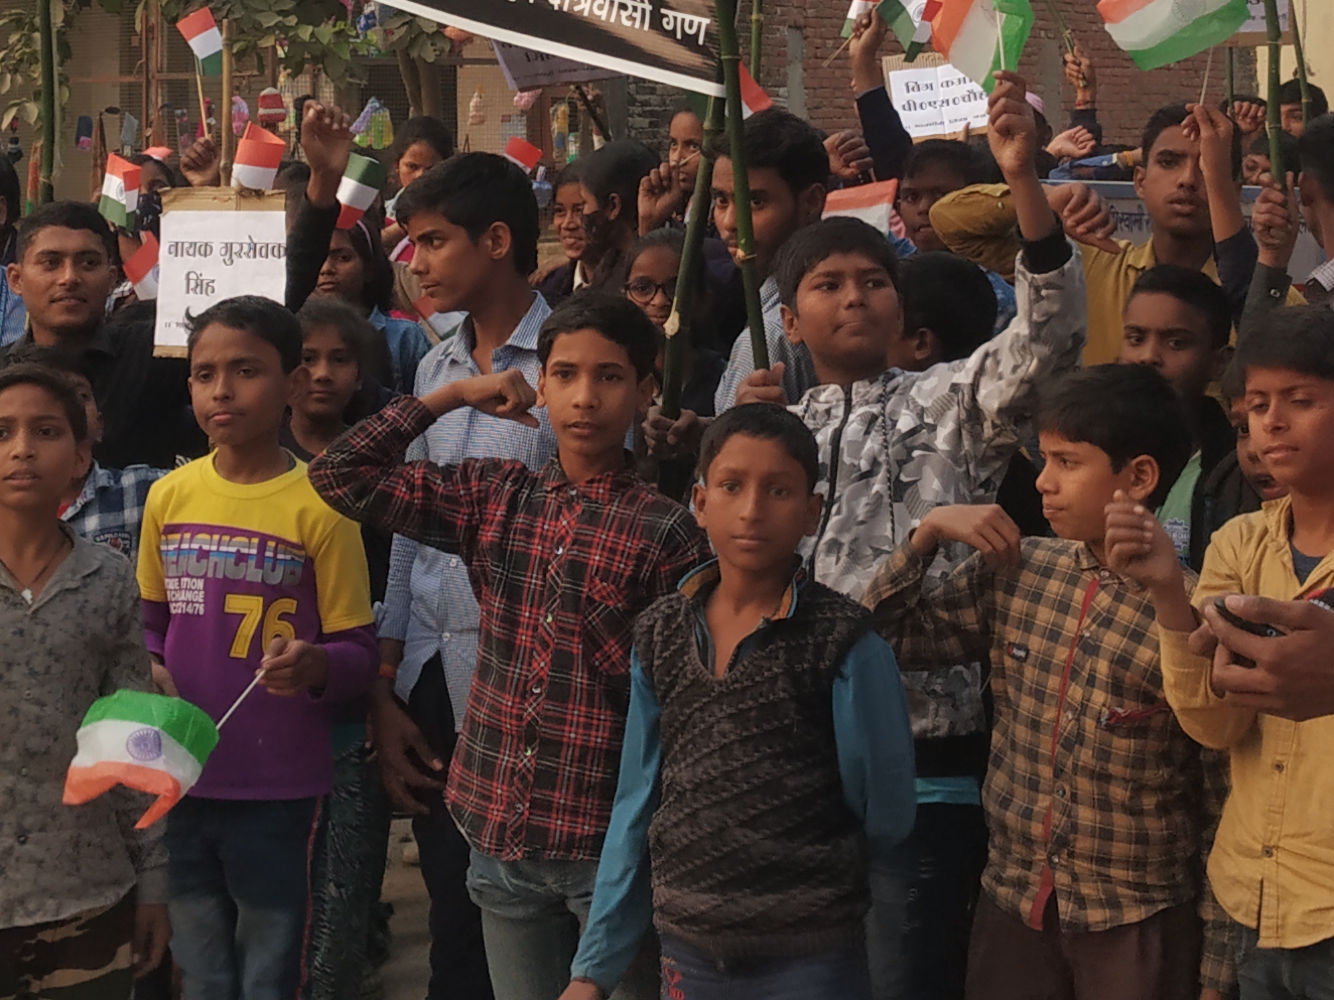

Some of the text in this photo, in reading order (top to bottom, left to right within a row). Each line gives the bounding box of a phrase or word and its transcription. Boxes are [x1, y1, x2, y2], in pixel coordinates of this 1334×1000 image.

[659, 7, 712, 47] गण
[167, 240, 215, 258] नायक
[185, 270, 216, 297] सिंह
